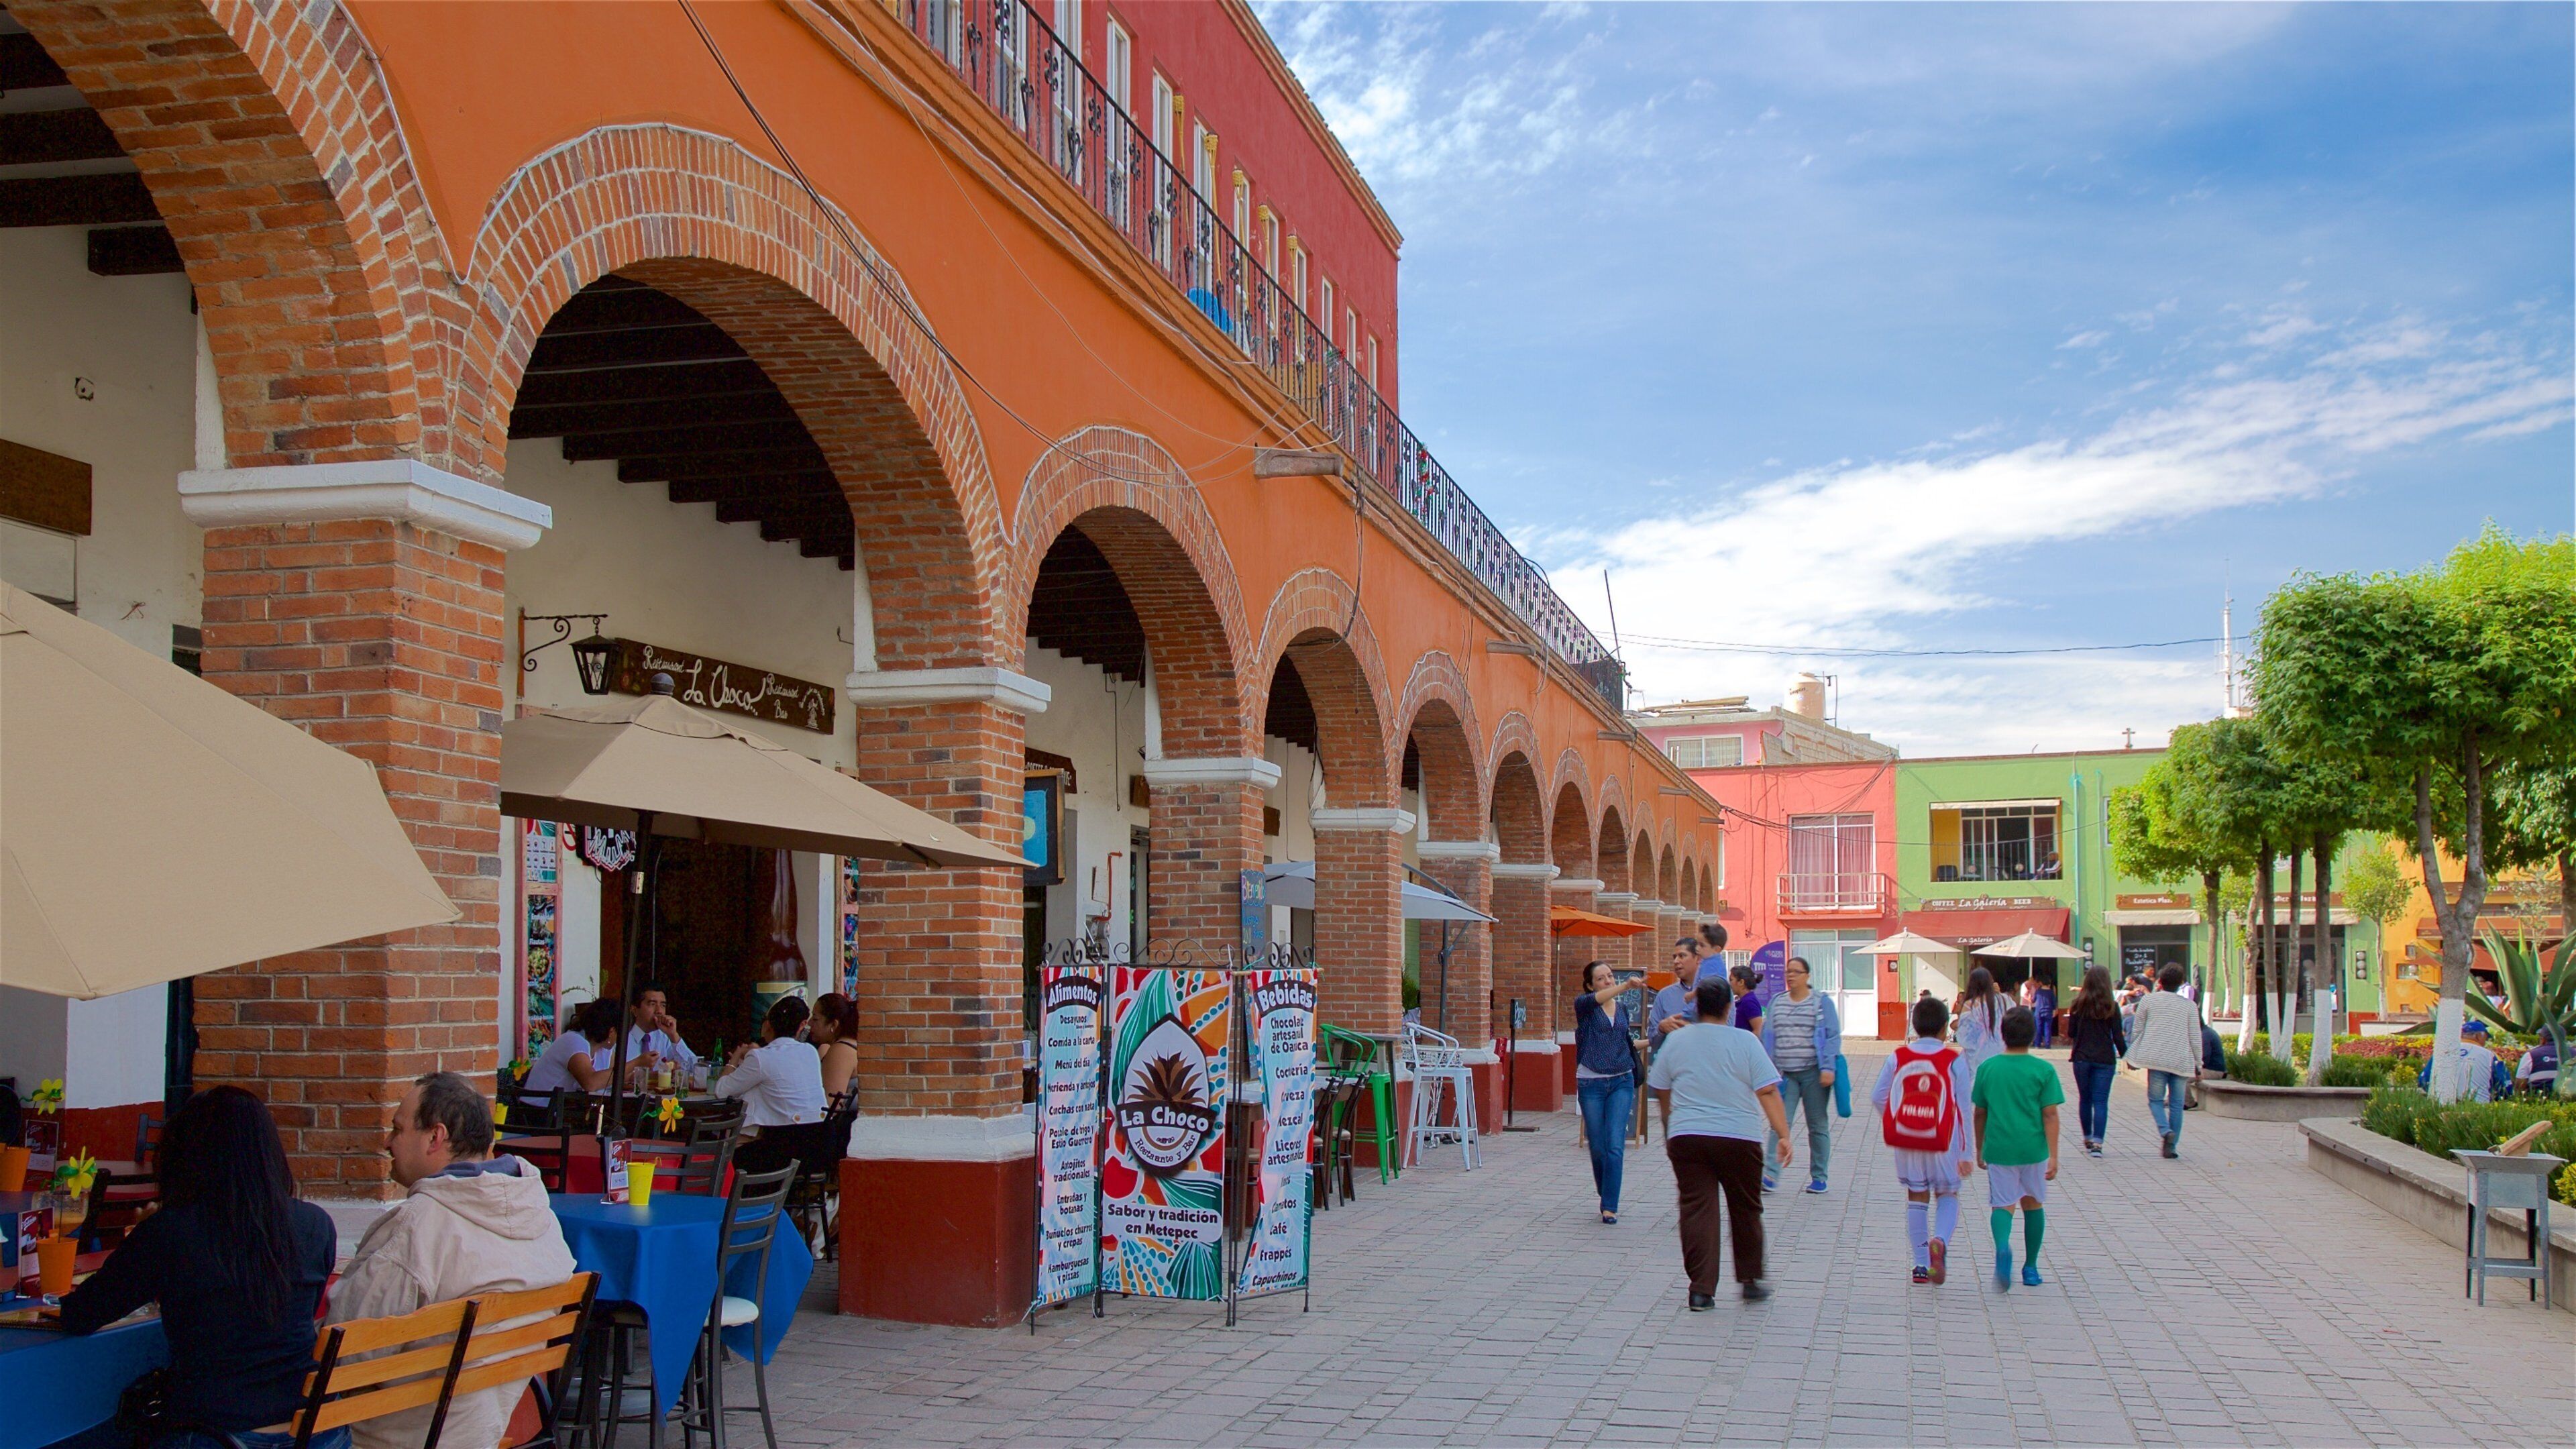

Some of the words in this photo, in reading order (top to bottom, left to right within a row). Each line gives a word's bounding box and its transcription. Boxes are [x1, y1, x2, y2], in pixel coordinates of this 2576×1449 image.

[683, 659, 706, 706] La
[1958, 899, 1972, 908] La
[1047, 983, 1097, 1007] Alimentos
[1257, 981, 1313, 1012] Bebidas
[1077, 1036, 1082, 1044] la
[1083, 1035, 1095, 1045] carta
[1271, 1041, 1281, 1054] de
[1073, 1059, 1082, 1068] del
[1075, 1083, 1079, 1092] y
[1049, 1104, 1075, 1116] Conchas
[1120, 1110, 1144, 1127] La
[1151, 1106, 1209, 1132] Choco
[1071, 1126, 1079, 1135] de
[1079, 1124, 1090, 1136] trigo
[1091, 1125, 1094, 1134] y
[1175, 1150, 1182, 1161] y
[1182, 1134, 1196, 1153] Bar
[1061, 1159, 1085, 1171] Antojitos
[1057, 1193, 1083, 1204] Entradas
[1083, 1193, 1087, 1202] y
[1059, 1204, 1083, 1216] botanas
[1108, 1203, 1145, 1218] Sabor
[1148, 1210, 1156, 1222] y
[1159, 1208, 1218, 1224] tradición
[1046, 1227, 1073, 1240] Buñuelos
[1075, 1223, 1093, 1234] churros
[1125, 1224, 1142, 1234] en
[1145, 1223, 1199, 1240] Metepec
[1057, 1241, 1061, 1252] y
[1063, 1236, 1083, 1249] crepas
[1260, 1245, 1292, 1262] Frappés
[1048, 1256, 1089, 1274] Hamburguesas
[1063, 1270, 1080, 1284] pizzas
[1252, 1271, 1297, 1287] Capuchinos
